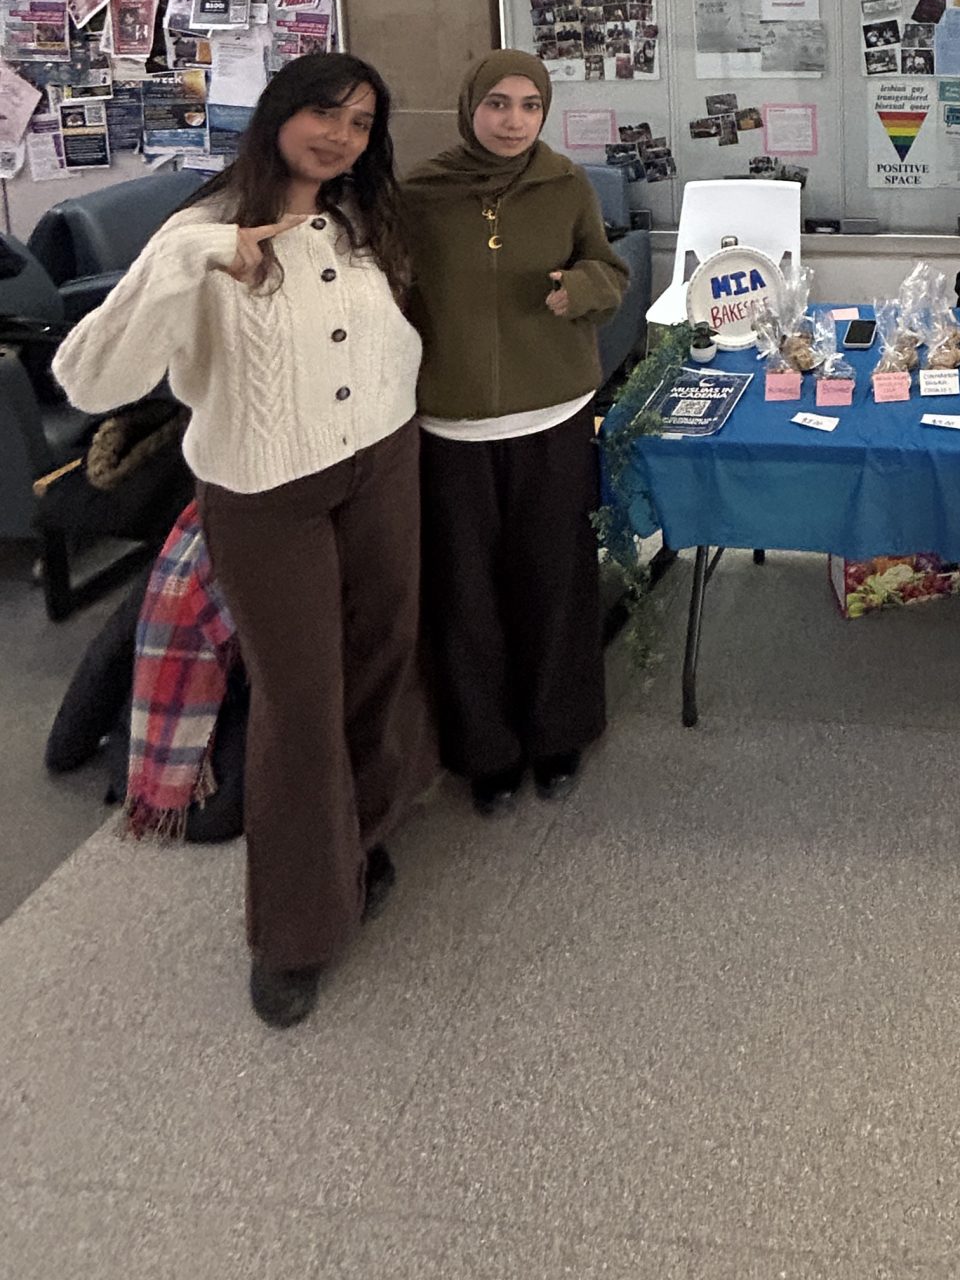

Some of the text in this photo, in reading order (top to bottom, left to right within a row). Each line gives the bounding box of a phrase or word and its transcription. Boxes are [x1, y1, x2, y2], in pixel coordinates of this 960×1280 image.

[880, 84, 906, 92] lesbian
[877, 94, 928, 102] transgendered
[874, 102, 905, 110] bisexual
[876, 163, 930, 174] POSITIVE
[884, 175, 922, 185] SPACE
[710, 268, 767, 300] MIA
[710, 295, 769, 330] BAKESAE
